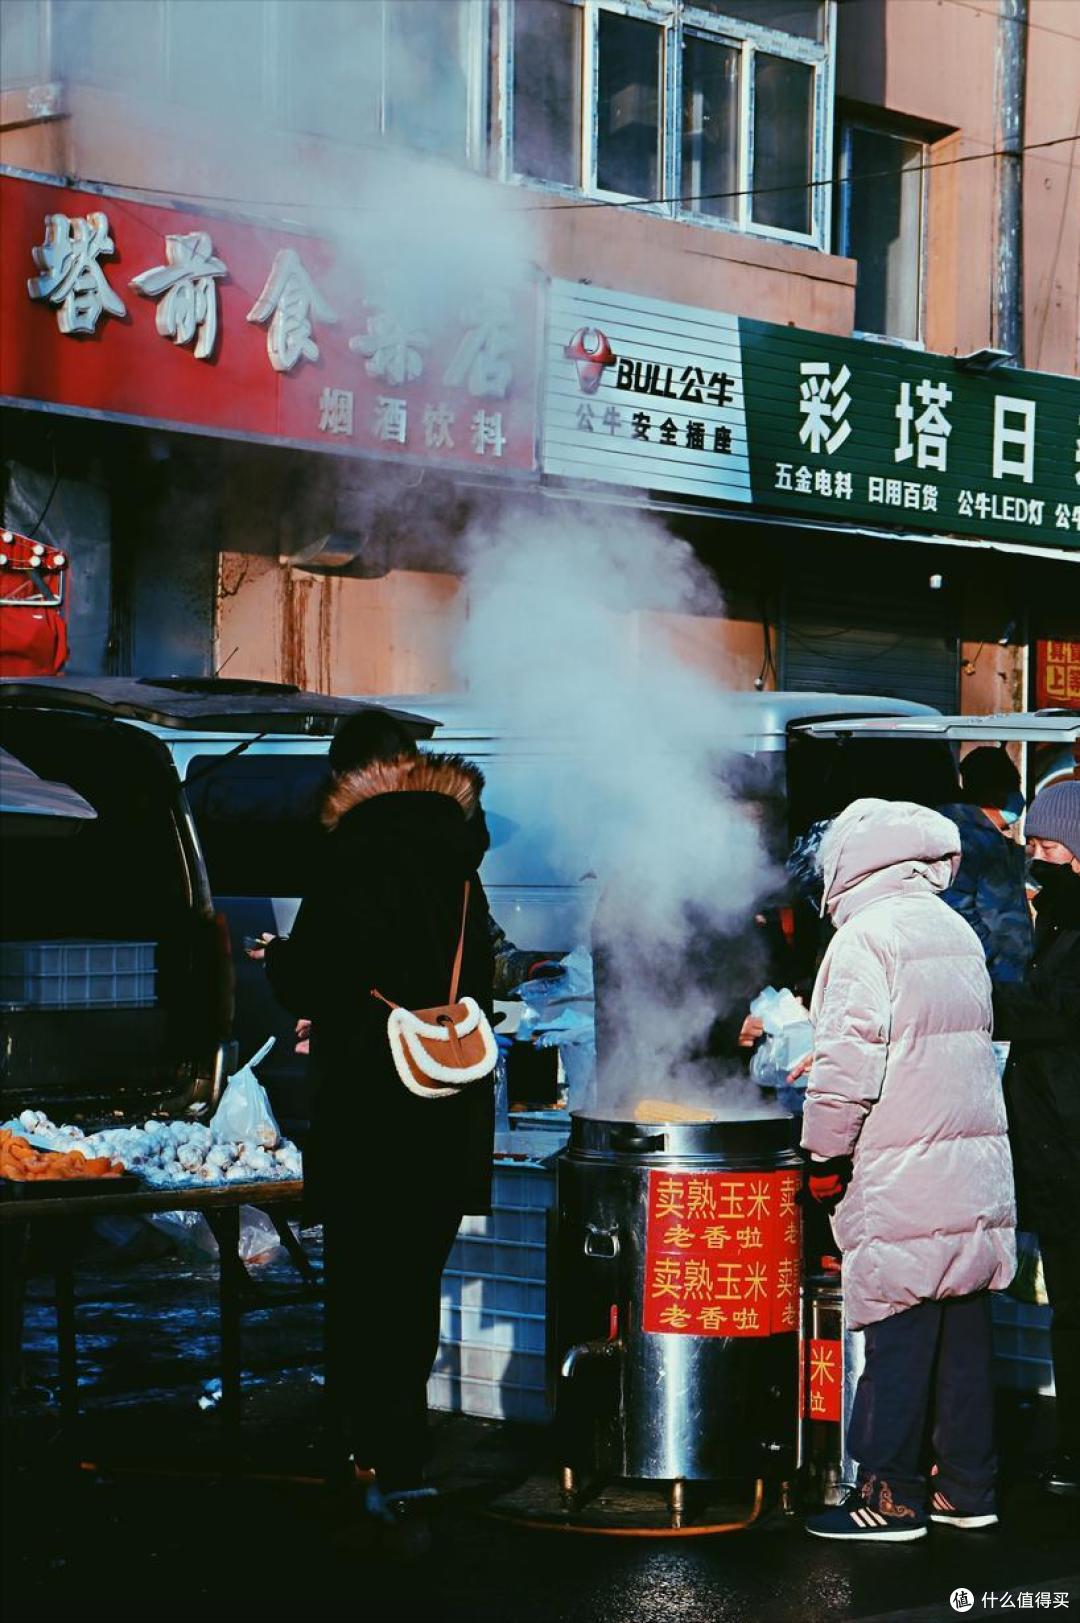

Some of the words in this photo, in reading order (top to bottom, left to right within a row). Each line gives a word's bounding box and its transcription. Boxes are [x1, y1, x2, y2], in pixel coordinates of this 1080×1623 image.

[319, 387, 506, 457] 烟酒饮料
[576, 402, 733, 454] 公牛安全插座
[799, 362, 1080, 486] 彩塔日
[774, 462, 853, 500] 五金电料
[868, 476, 938, 512] 日用百货
[958, 489, 1045, 525] 公牛LED灯
[655, 1177, 771, 1221] 卖熟玉米
[663, 1223, 763, 1249] 老香啦
[652, 1258, 768, 1302] 卖熟玉米
[659, 1304, 760, 1330] 老香啦
